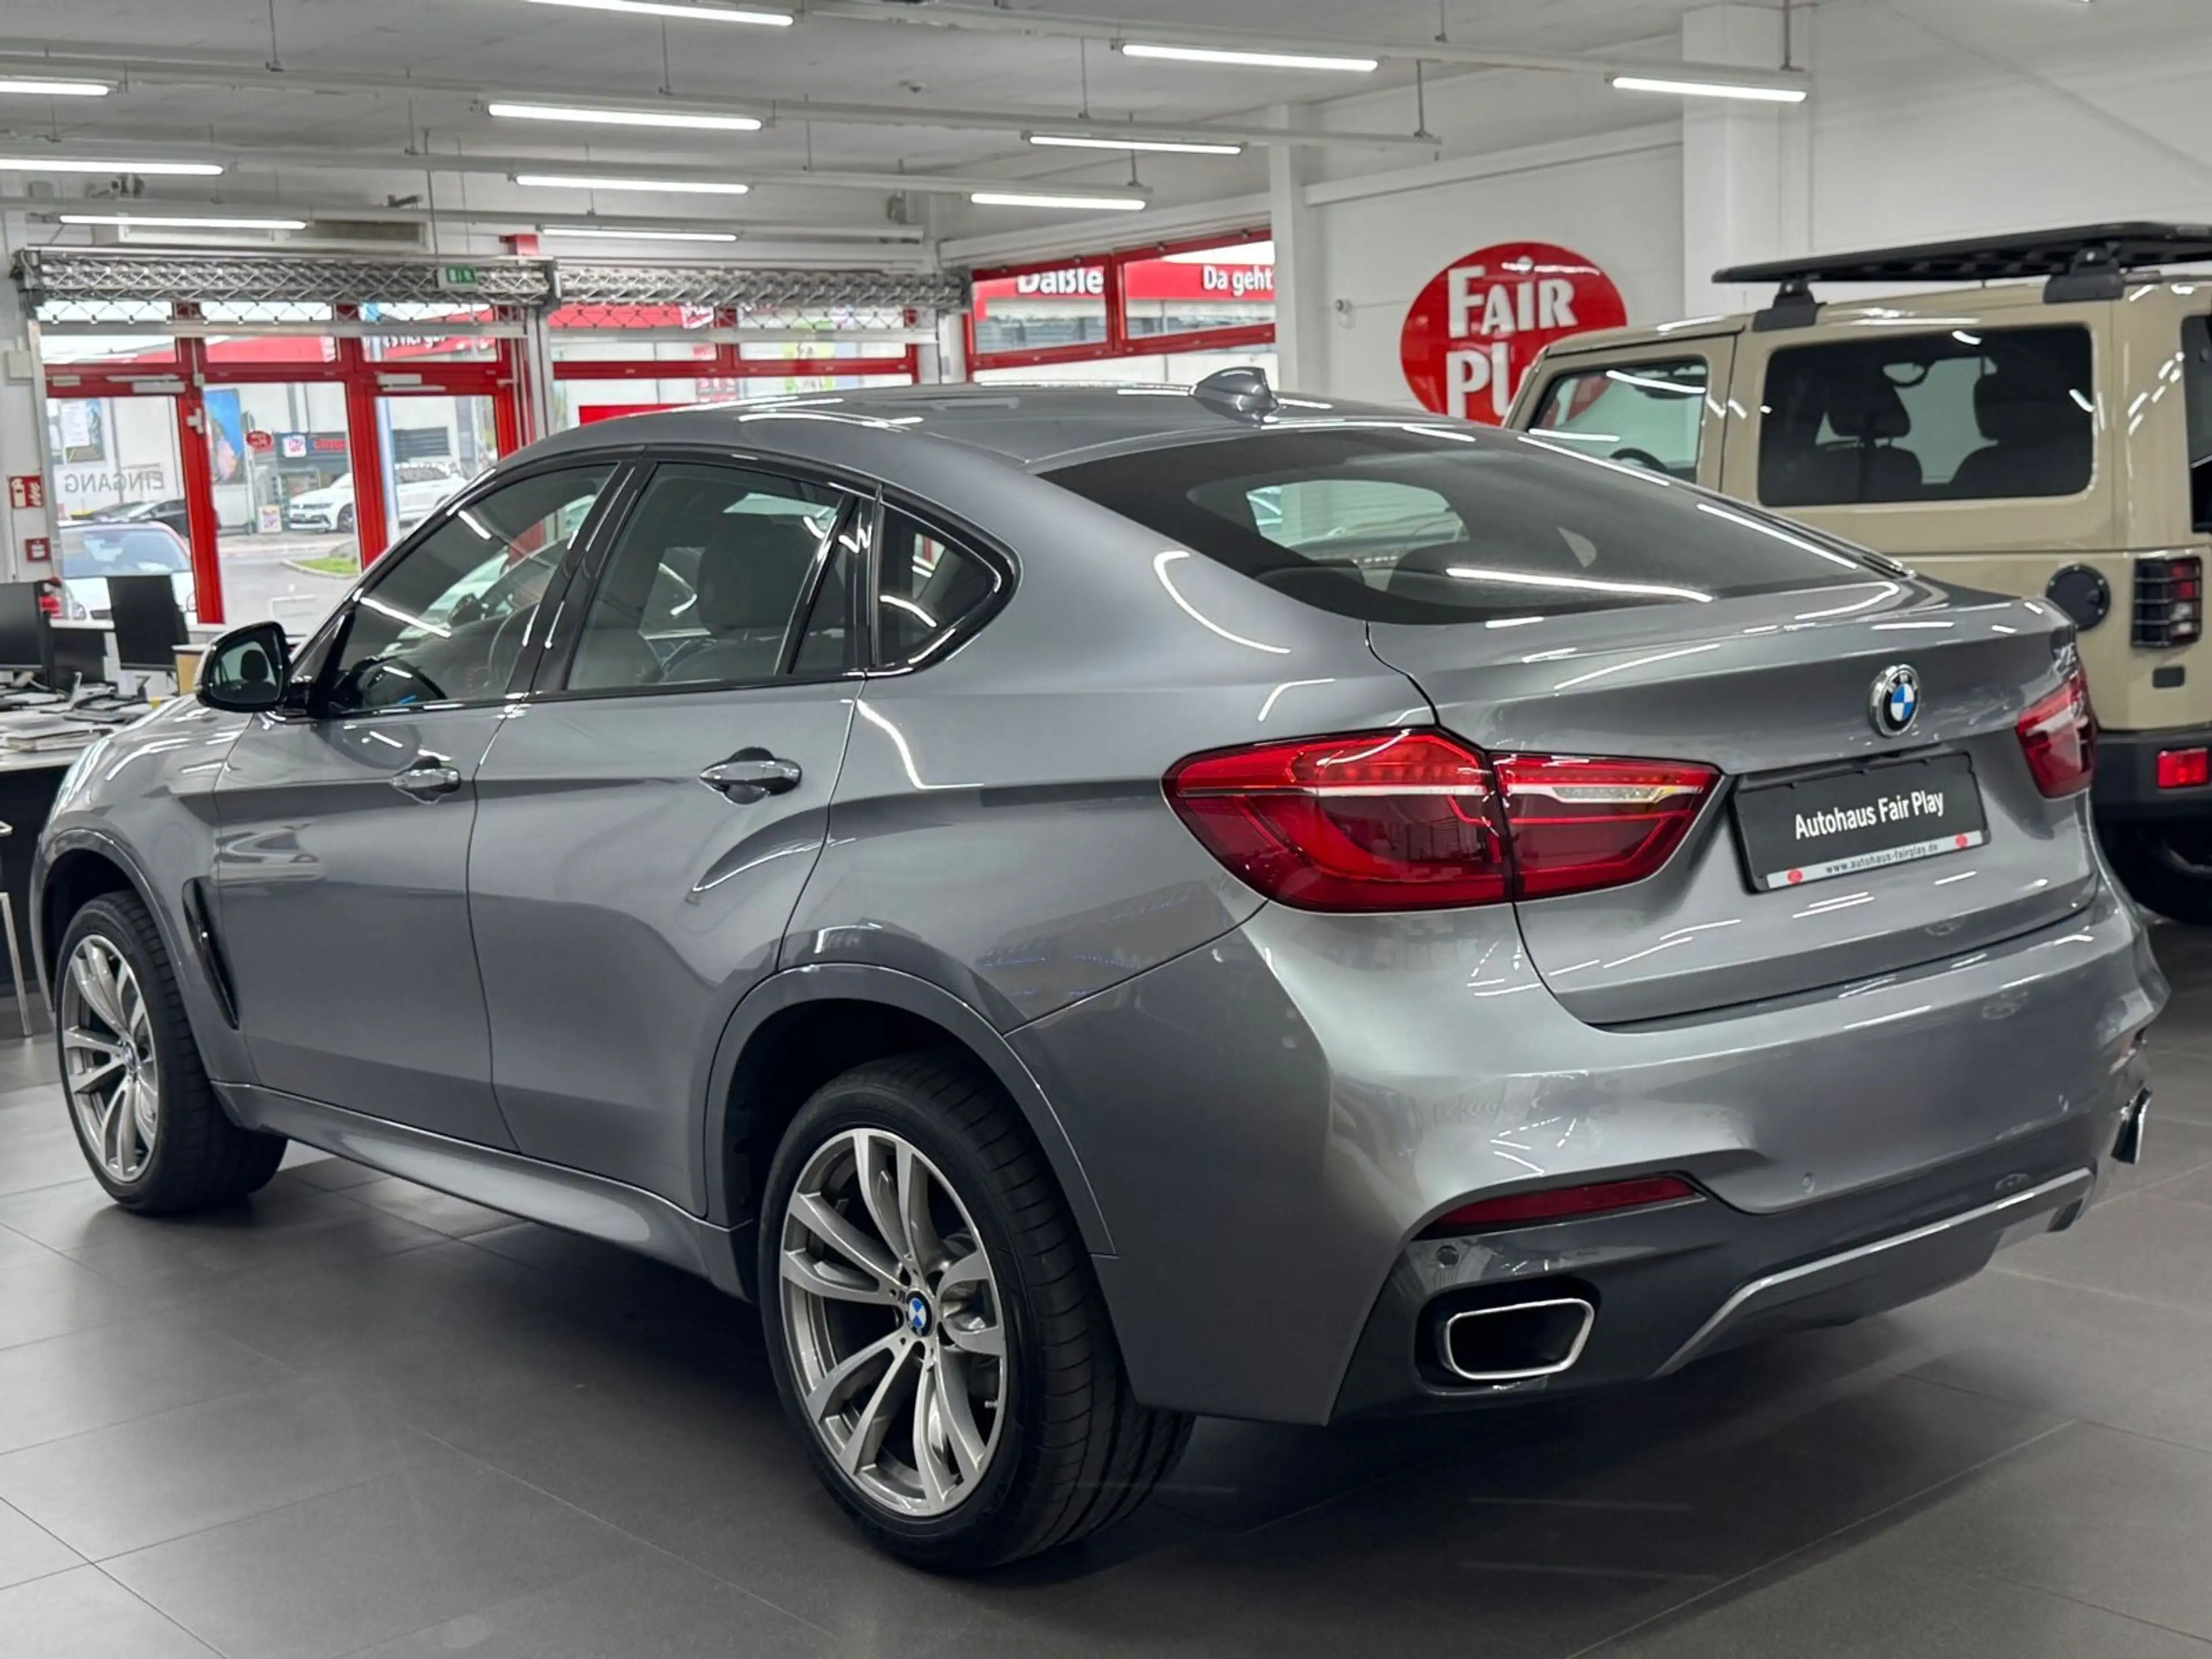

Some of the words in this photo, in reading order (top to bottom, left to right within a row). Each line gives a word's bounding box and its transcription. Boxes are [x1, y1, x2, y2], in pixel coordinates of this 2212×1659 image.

[1203, 265, 1228, 290] Da
[1232, 265, 1274, 297] geht
[1795, 807, 1877, 840] Autohaus
[1878, 794, 1910, 823] Fair
[1911, 790, 1944, 817] Play
[1825, 843, 1938, 874] www.autohaus-fairplay.de
